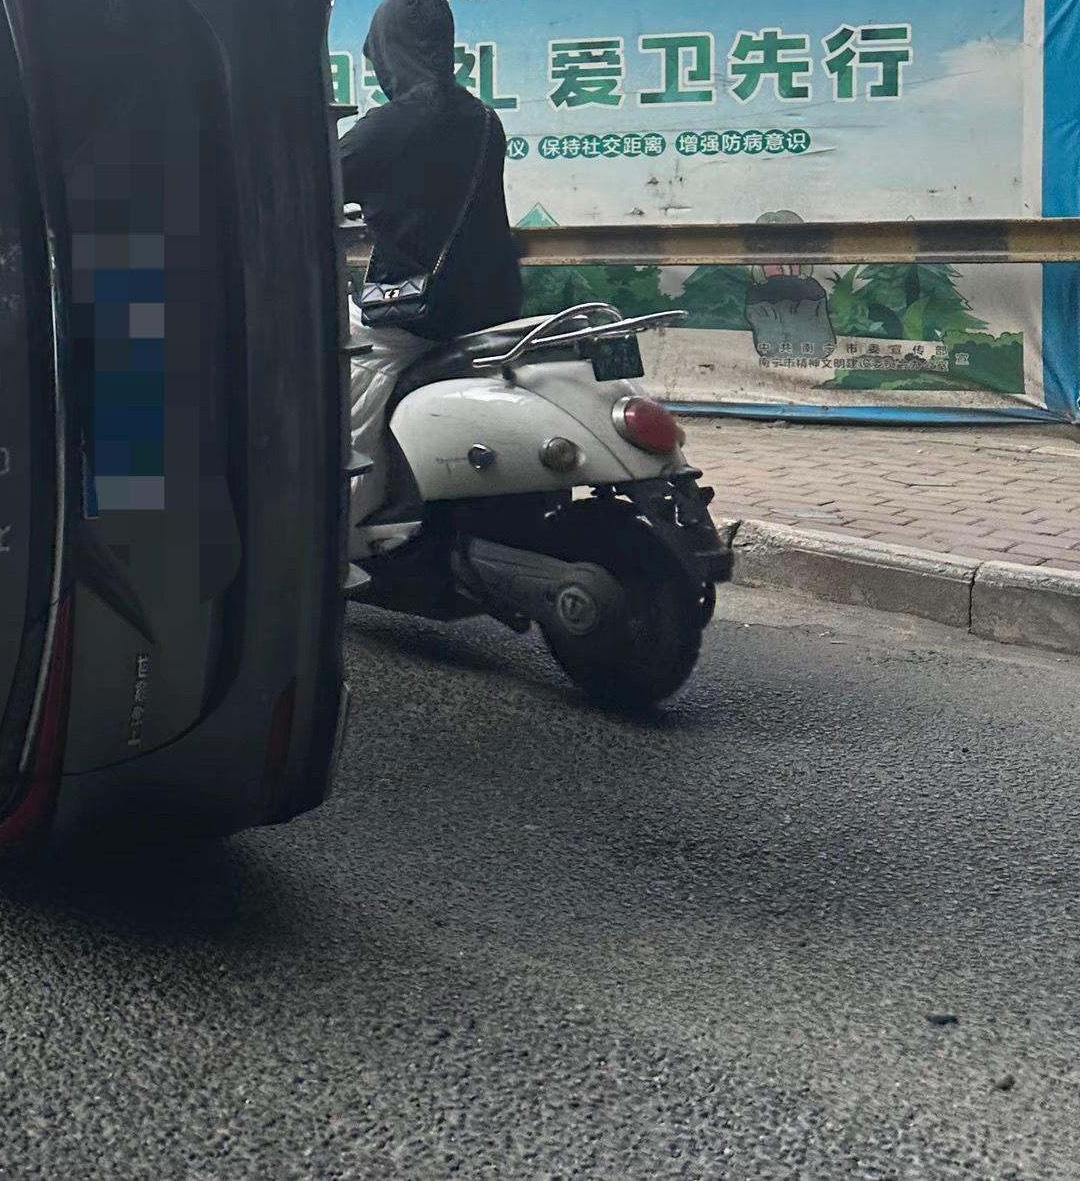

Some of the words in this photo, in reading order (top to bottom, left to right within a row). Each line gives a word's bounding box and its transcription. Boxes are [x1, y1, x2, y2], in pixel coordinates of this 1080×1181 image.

[550, 24, 912, 110] 爱卫先行
[540, 134, 665, 157] 保持社交距离
[678, 131, 810, 154] 增强防病意识
[758, 340, 949, 356] 中共南宁市委宣传部
